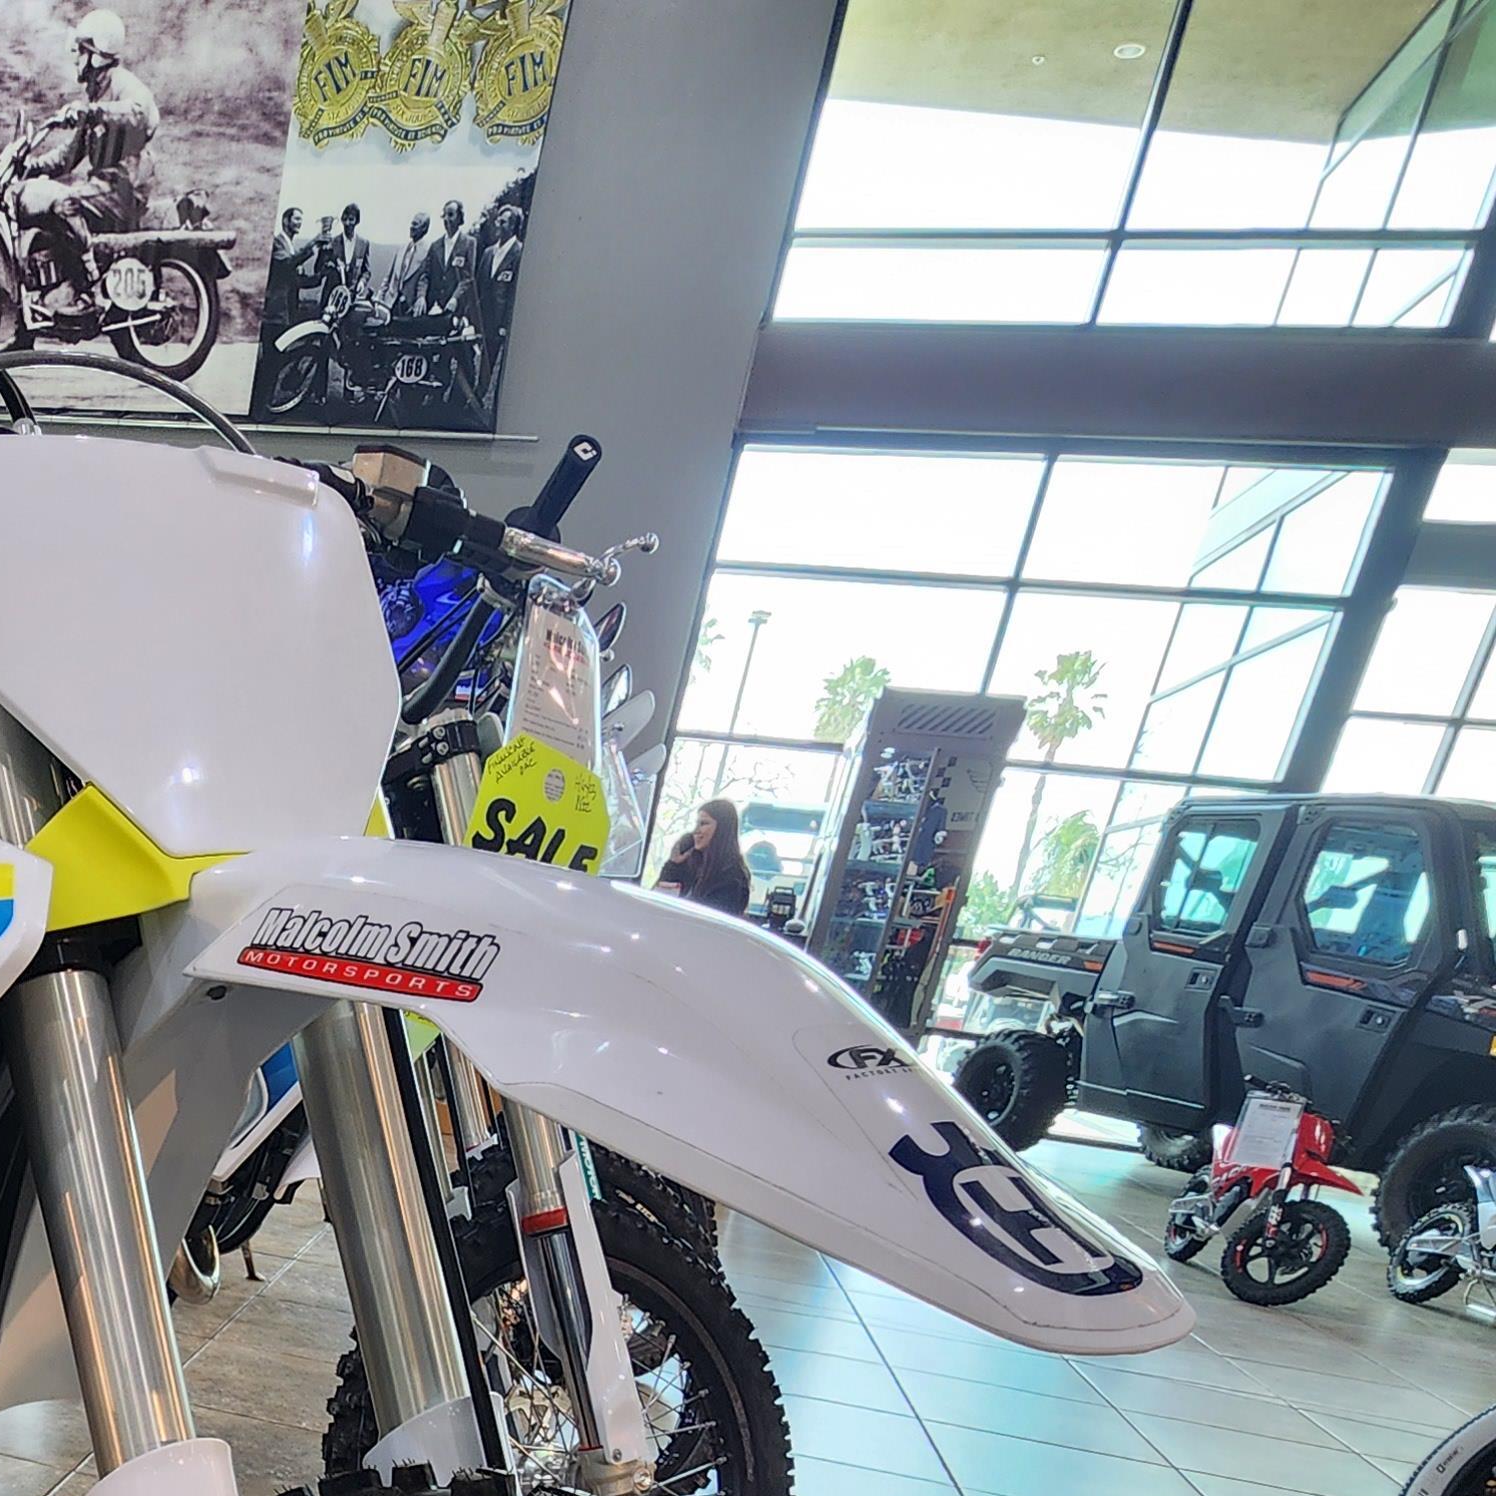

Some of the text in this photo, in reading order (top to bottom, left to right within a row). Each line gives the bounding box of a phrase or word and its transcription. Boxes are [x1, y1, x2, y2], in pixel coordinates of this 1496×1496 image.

[313, 49, 357, 103] FIM
[403, 57, 447, 98] FIM
[504, 50, 549, 97] FIM
[251, 907, 502, 981] Malcolm Smith
[1007, 947, 1072, 966] RANGER
[245, 951, 477, 998] MOTORSPORTS
